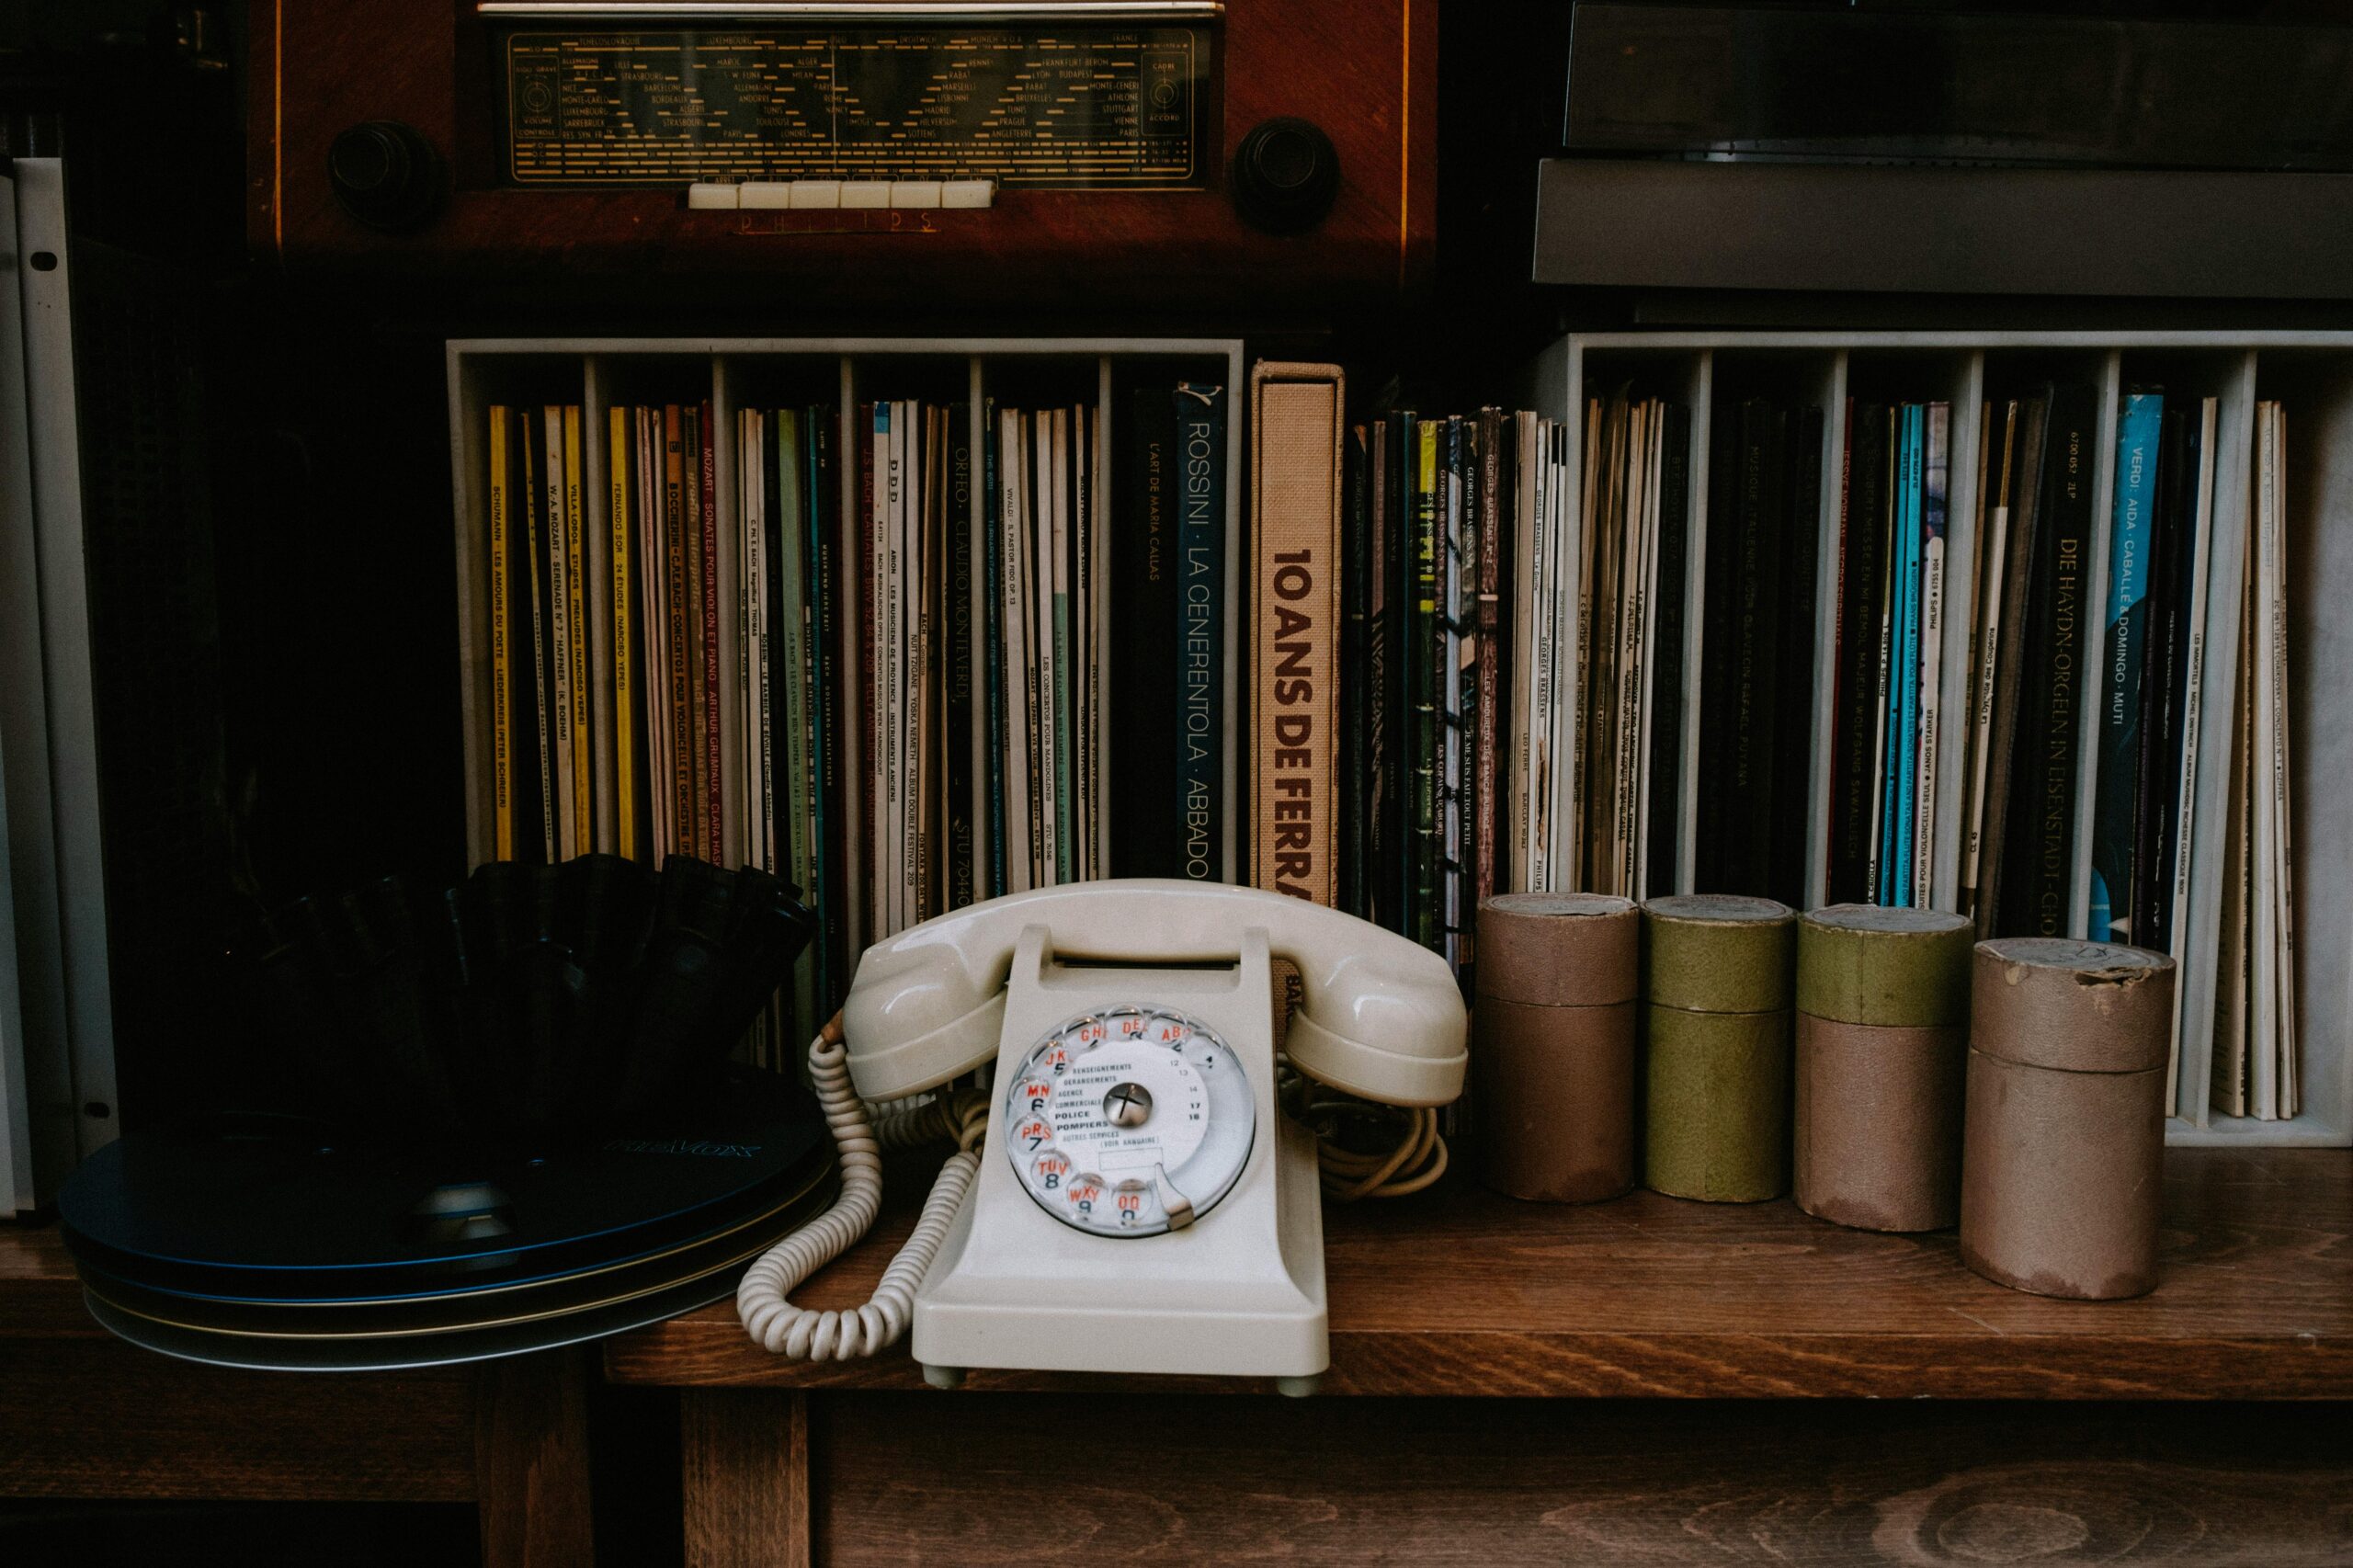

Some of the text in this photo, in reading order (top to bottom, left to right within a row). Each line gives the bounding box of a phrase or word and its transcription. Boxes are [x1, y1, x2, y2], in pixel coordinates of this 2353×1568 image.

[1485, 454, 1495, 494] GEORGES
[550, 485, 559, 509] W.-A.
[1006, 488, 1015, 517] VIVALDI
[1149, 442, 1161, 581] L'ART DE MARIA CALLAS
[1485, 496, 1495, 544] BRASSENS
[1007, 533, 1016, 562] PASTOR
[1485, 545, 1494, 554] N°
[614, 483, 625, 691] FERNANDO SOR 24 ÉTUDES (NARCISO YEPES)
[955, 447, 970, 698] ORFEO CLAUDIO MONTEVERDI
[1274, 548, 1313, 601] 10
[2112, 447, 2143, 725] VERDI: AIDA CABALLÉ & DOMINGO MUTI
[493, 485, 506, 808] SCHUMANN LES AMOURS DU POETE LIEDERKREIS (PETER SCHREIER)
[704, 448, 721, 837] MOZART SONATES POUR VIOLON ET PIANO ARTHUR GRUMIAUX CLARA
[890, 648, 896, 659] DE
[910, 634, 918, 653] NUIT
[1187, 422, 1211, 879] ROSSINI LA CENERENTOLA ABBADO
[1274, 605, 1313, 705] ANS
[1484, 676, 1493, 693] LES
[909, 697, 917, 724] YOSKA
[1483, 695, 1493, 741] AMOUREUX
[2043, 539, 2078, 879] DIE HAYDN-ORGELN IN EISENSTADT
[676, 676, 690, 837] POUR VIOLONCELLE ET ORCHESTRE
[1274, 716, 1313, 769] DE
[1483, 745, 1492, 762] DES
[1535, 636, 1548, 891] GEORGES BRASSENS PHILIPS
[908, 767, 916, 797] ALBUM
[1463, 731, 1472, 846] JE ME SUIS FAIT TOUT PETIT
[1483, 765, 1492, 792] BANCS
[1919, 709, 1933, 881] POUR VIOLONCELLE SEUL JANOS STARKER
[907, 832, 915, 869] FESTIVAL
[1970, 832, 1978, 840] 45
[1970, 843, 1977, 853] CL
[1054, 1110, 1090, 1119] POLICE
[1056, 1120, 1108, 1131] POMPIERS
[1021, 1122, 1051, 1140] PRS
[1029, 1136, 1042, 1151] 7
[1038, 1159, 1068, 1174] TUV
[1045, 1174, 1059, 1188] 8
[1069, 1185, 1099, 1202] WXY
[1078, 1199, 1091, 1213] 9
